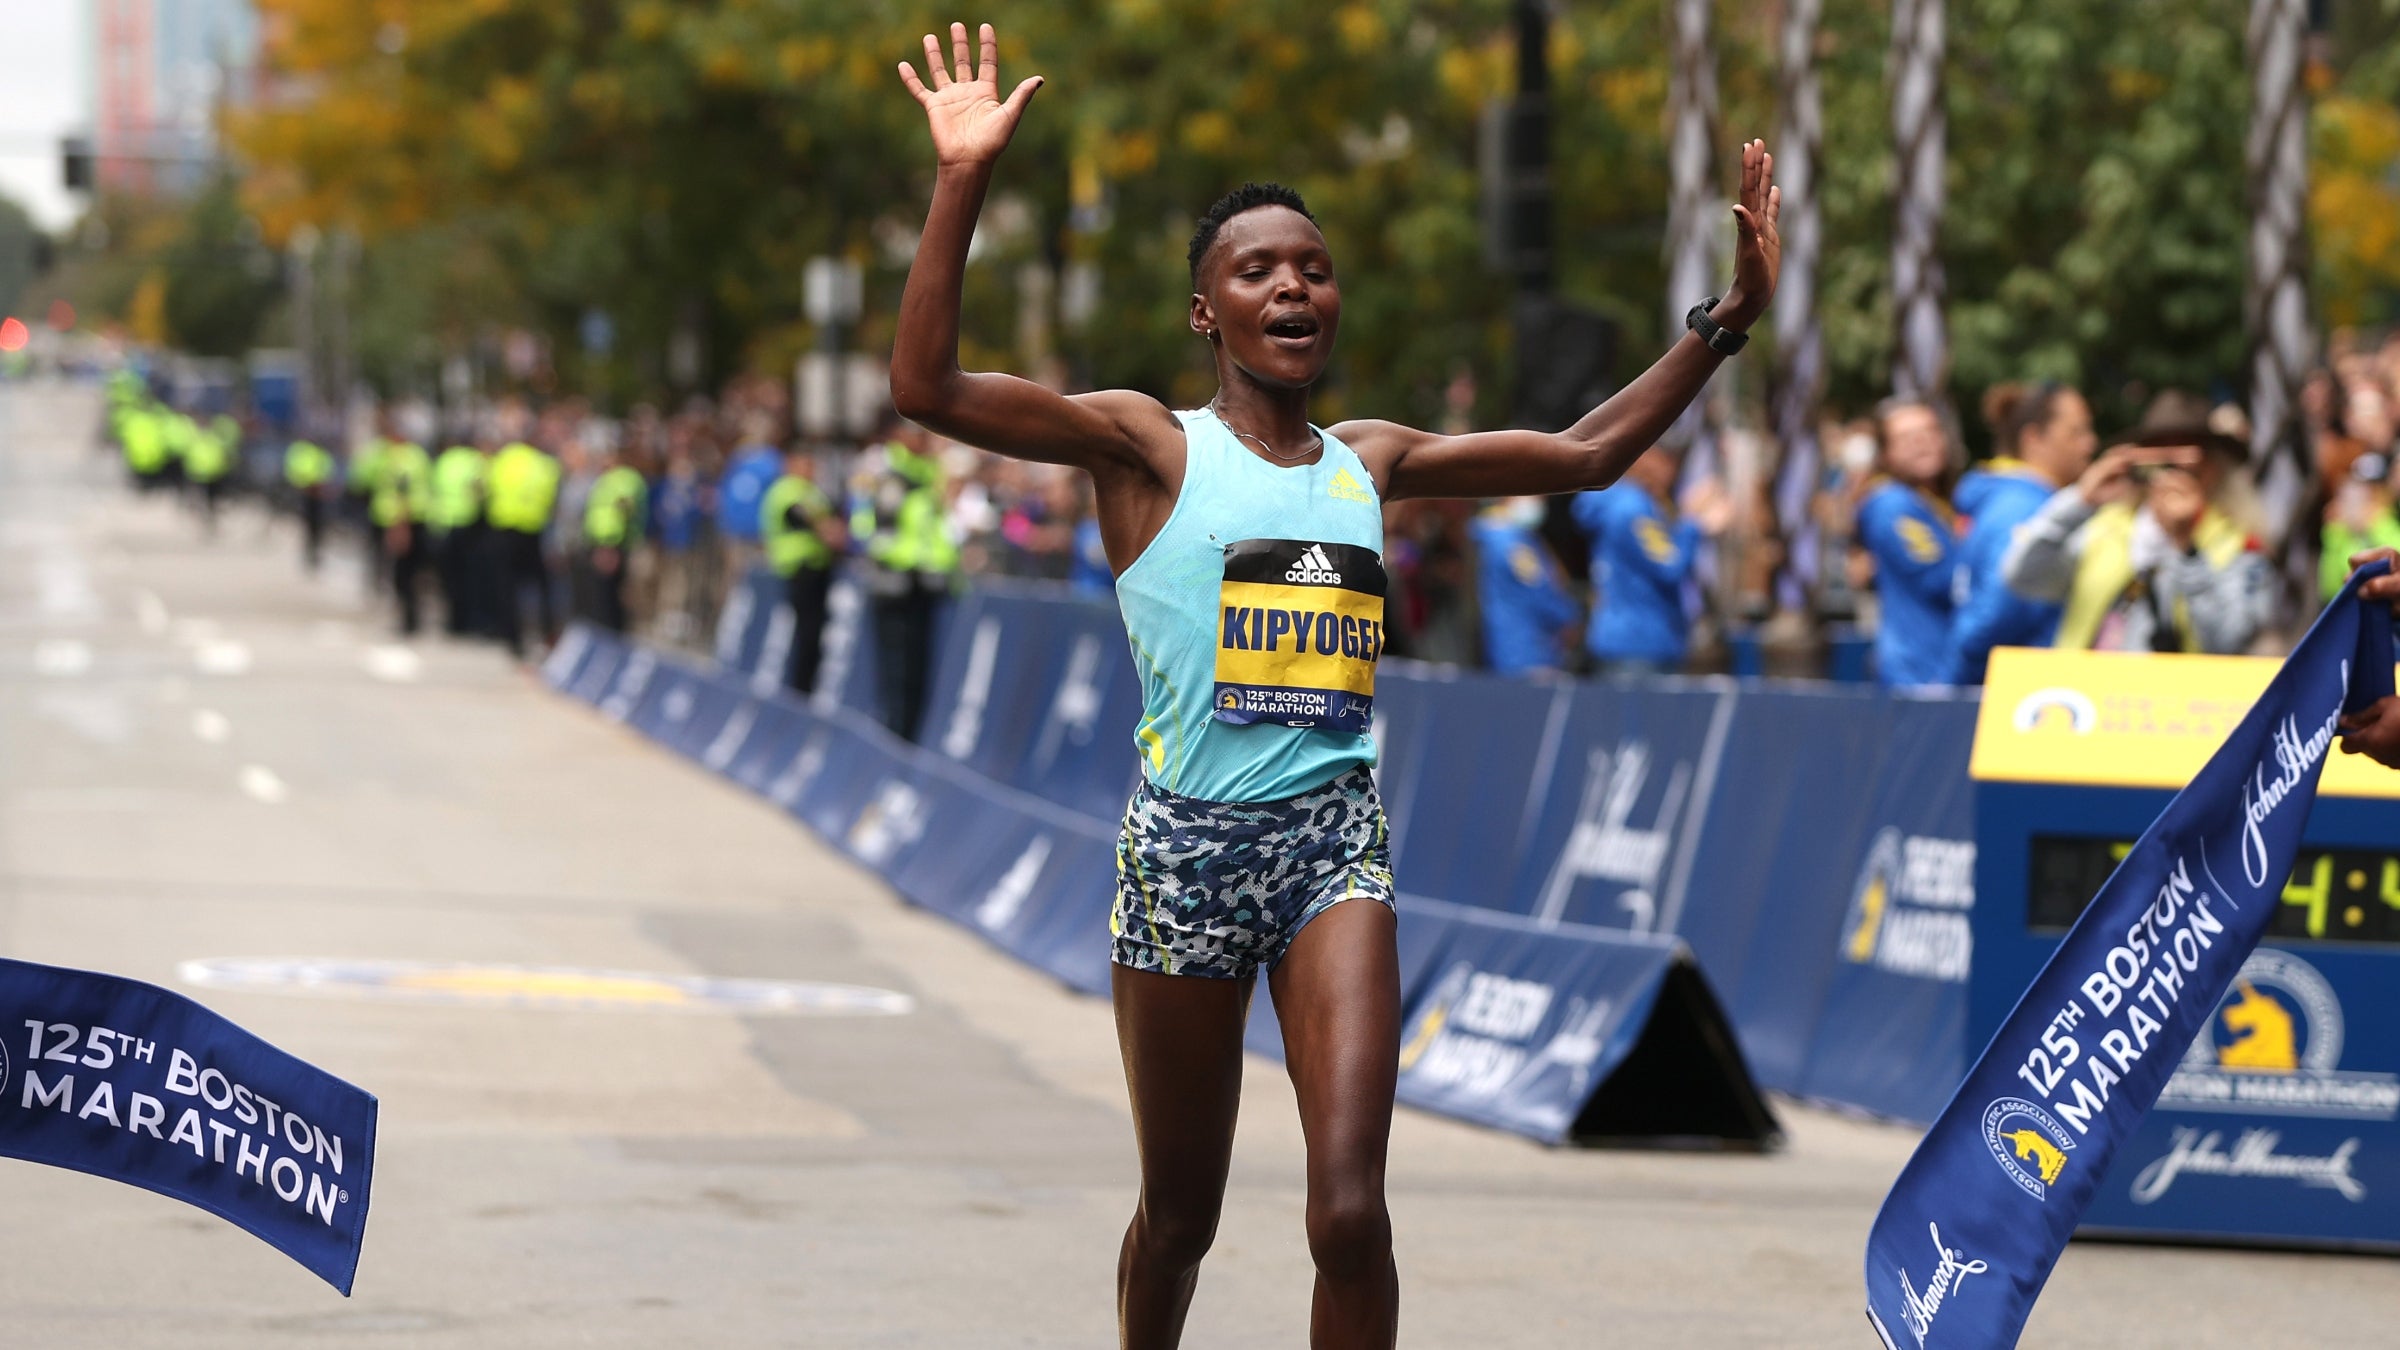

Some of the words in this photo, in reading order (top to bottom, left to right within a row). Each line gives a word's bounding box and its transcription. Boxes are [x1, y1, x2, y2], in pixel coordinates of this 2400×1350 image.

[1285, 567, 1342, 585] adidas
[1245, 690, 1274, 702] 125TH
[1274, 691, 1325, 705] BOSTON
[1245, 702, 1327, 716] MARATHON
[2241, 760, 2292, 889] John
[2017, 1000, 2086, 1099] 125TH
[2080, 856, 2195, 1018] BOSTON
[24, 1018, 156, 1069] 125TH
[164, 1048, 344, 1175] BOSTON
[1986, 1106, 2003, 1152] ATHLETIC
[2000, 1101, 2070, 1147] ASSOCIATION
[1998, 1153, 2042, 1194] BOSTON
